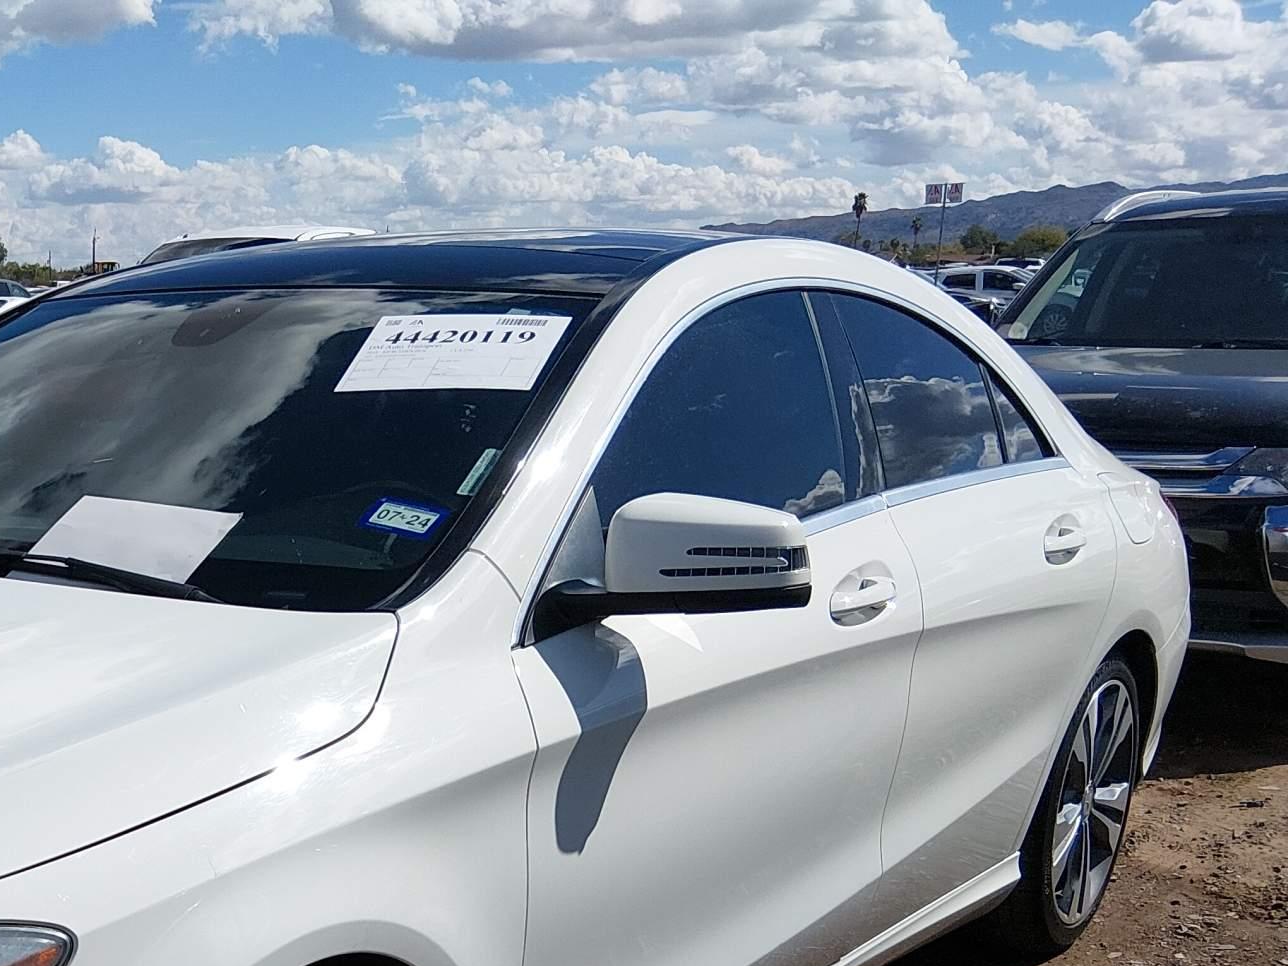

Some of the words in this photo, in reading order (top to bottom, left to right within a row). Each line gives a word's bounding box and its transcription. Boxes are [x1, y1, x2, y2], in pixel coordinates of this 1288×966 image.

[385, 329, 537, 345] 44420119
[377, 509, 402, 522] 07
[405, 514, 432, 529] 24
